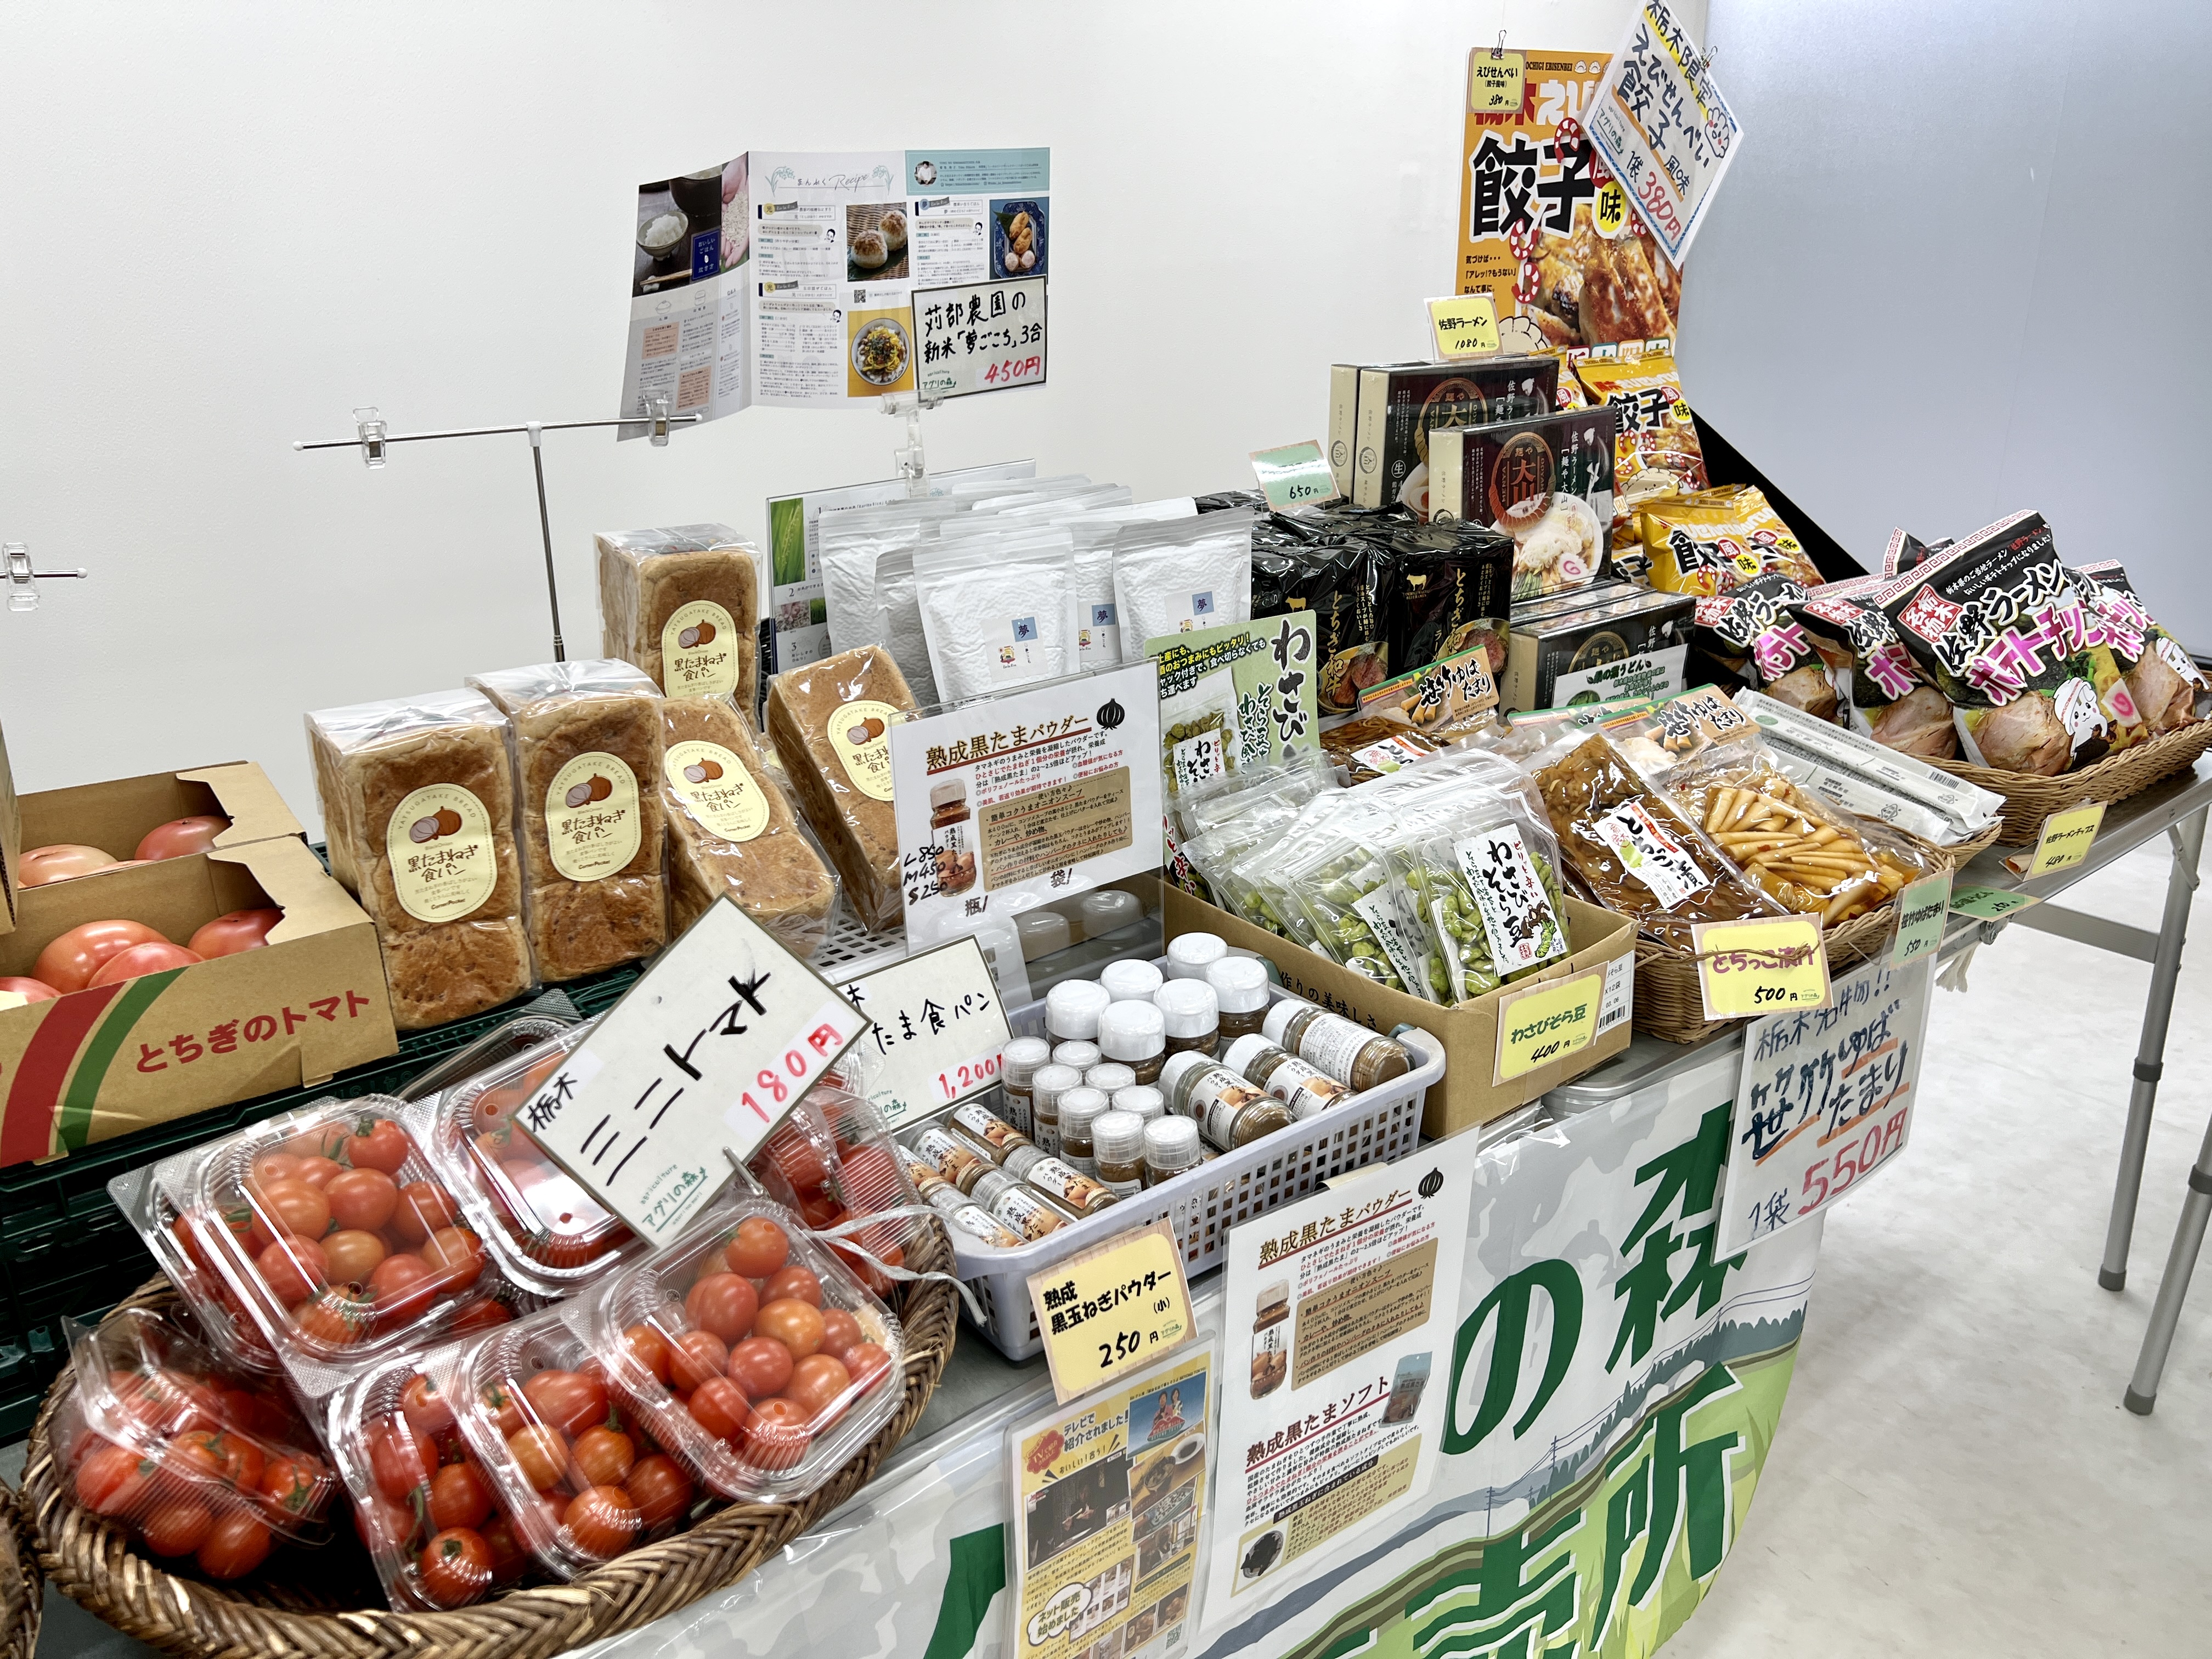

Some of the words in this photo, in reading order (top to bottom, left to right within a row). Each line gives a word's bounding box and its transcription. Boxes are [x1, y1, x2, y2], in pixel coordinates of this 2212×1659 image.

[1477, 66, 1518, 78] えびせんべい
[1525, 61, 1544, 71] OCHIGI
[1545, 62, 1572, 71] EBISENBEI
[1489, 94, 1503, 105] 380
[1632, 23, 1709, 168] えびせんべい
[1617, 60, 1671, 150] 餃子
[1664, 155, 1690, 195] 風味
[828, 173, 870, 193] Recipe
[1474, 137, 1593, 236] 餃子
[1638, 171, 1681, 240] 380円
[698, 238, 715, 247] おいしい
[699, 246, 714, 254] ごはん
[1464, 285, 1495, 293] なんて事に。
[925, 291, 1026, 337] 苅部農園の
[1438, 317, 1487, 330] 佐野ラーメン
[984, 356, 1041, 383] 450円
[1607, 388, 1669, 433] 餃子
[1394, 462, 1403, 475] 生
[1571, 431, 1579, 495] 佐野ラーメン
[1290, 485, 1311, 499] 650
[1511, 460, 1536, 504] 大山
[1946, 549, 2007, 594] 栃木県のご当地ラーメン
[789, 588, 794, 597] 2
[1197, 598, 1207, 612] 夢
[670, 608, 710, 635] YATSUGATAKE
[712, 612, 727, 630] BREAD
[1018, 624, 1029, 639] 夢
[1097, 610, 1108, 623] 夢
[1933, 561, 2066, 675] 佐野ラーメン
[791, 642, 797, 651] 3
[1326, 590, 1345, 697] とちぎ和牛
[675, 653, 727, 672] 黒たまねぎ
[683, 667, 716, 681] 食パン
[1271, 619, 1312, 742] わさび
[1462, 673, 1492, 701] たまり
[709, 749, 731, 764] BREAD
[926, 715, 1088, 770] 熟成黒たまパウダー
[556, 761, 602, 795] YATSUGATAKE
[606, 764, 626, 785] BREAD
[690, 782, 743, 802] 黒たまねぎ
[398, 794, 449, 829] YATSUGATAKE
[453, 797, 476, 818] BREAD
[707, 799, 741, 812] 食パン
[561, 810, 625, 835] 黒たまねぎ
[572, 827, 612, 844] 食パン
[408, 845, 478, 872] 黒たまねぎ
[919, 844, 944, 863] 850
[2046, 854, 2064, 868] 480
[421, 863, 466, 882] 食パン
[919, 861, 946, 879] 450
[1487, 840, 1529, 908] わさび
[1514, 841, 1538, 898] ピリッと辛い
[921, 881, 948, 900] 250
[1482, 867, 1523, 948] そら豆
[1900, 900, 1945, 930] 笹竹ゆばたまり
[1904, 938, 1921, 957] 550
[1754, 987, 1785, 1005] 500
[1790, 992, 1797, 1001] 円
[136, 989, 370, 1074] とちぎのトマト
[872, 993, 990, 1055] たま食パン
[1511, 1003, 1587, 1044] わさびそら豆
[1531, 1041, 1560, 1063] 400
[1563, 1040, 1570, 1048] 円
[579, 969, 772, 1188] ミニトマト
[740, 1022, 844, 1124] 180円
[939, 1053, 1002, 1099] 1,200
[527, 1073, 579, 1133] 栃木
[1826, 1040, 1908, 1139] たまり
[640, 1164, 678, 1205] agriculture
[1748, 1188, 1790, 1240] 1袋
[1798, 1106, 1908, 1216] 550円
[641, 1170, 699, 1227] アグリの森
[1260, 1189, 1412, 1265] 熟成黒たまパウダー
[1043, 1280, 1078, 1311] 熟成
[1051, 1271, 1171, 1335] 黒玉ねぎパウダー
[1154, 1297, 1170, 1314] (小)
[1099, 1330, 1140, 1368] 250
[1149, 1331, 1159, 1344] 円
[1064, 1412, 1096, 1435] テレビで
[1247, 1376, 1389, 1467] 熟成黒たまソフト
[1039, 1591, 1081, 1622] ネット販売
[1037, 1606, 1079, 1638] 始めました
